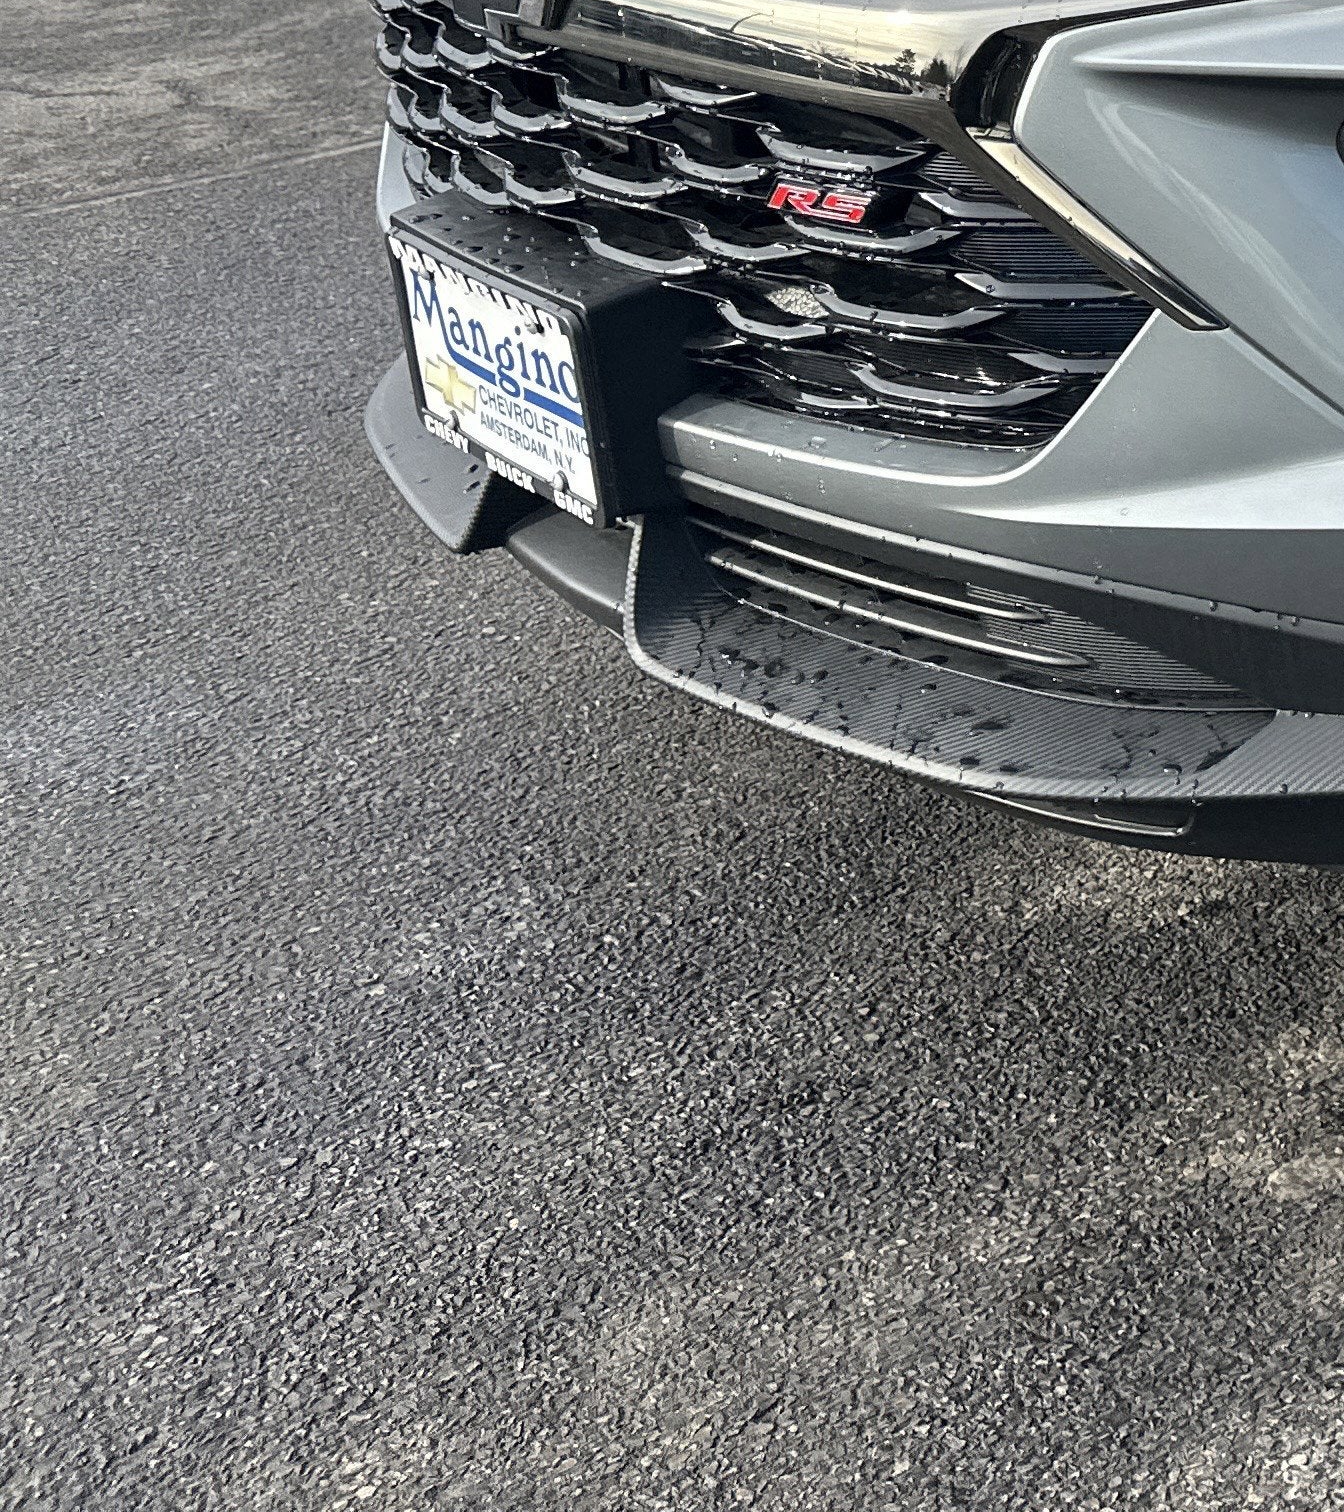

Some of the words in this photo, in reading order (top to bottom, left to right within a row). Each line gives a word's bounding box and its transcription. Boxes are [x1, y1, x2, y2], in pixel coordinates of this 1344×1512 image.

[767, 183, 871, 224] RS
[408, 266, 582, 405] Mangino
[478, 384, 564, 448] CHEVROLET,
[424, 414, 470, 454] CHEVY
[484, 451, 536, 494] BUICK
[553, 489, 594, 525] GMC
